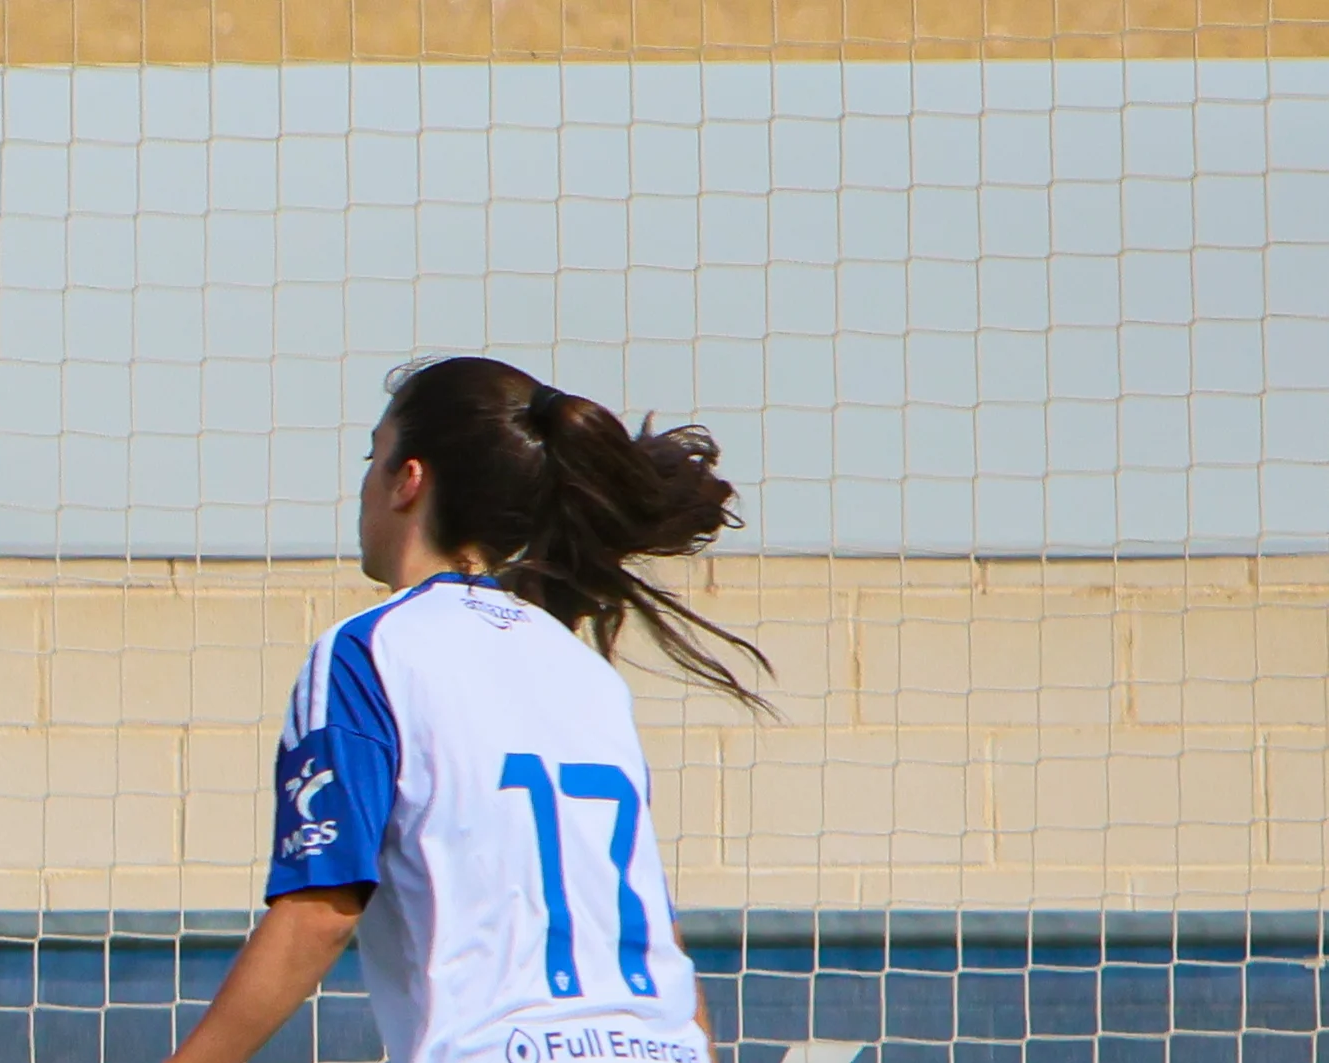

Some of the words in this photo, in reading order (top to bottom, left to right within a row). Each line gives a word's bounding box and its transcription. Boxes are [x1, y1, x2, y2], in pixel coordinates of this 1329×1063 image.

[282, 820, 338, 859] MGS
[499, 753, 659, 998] 17
[544, 1028, 604, 1061] Full
